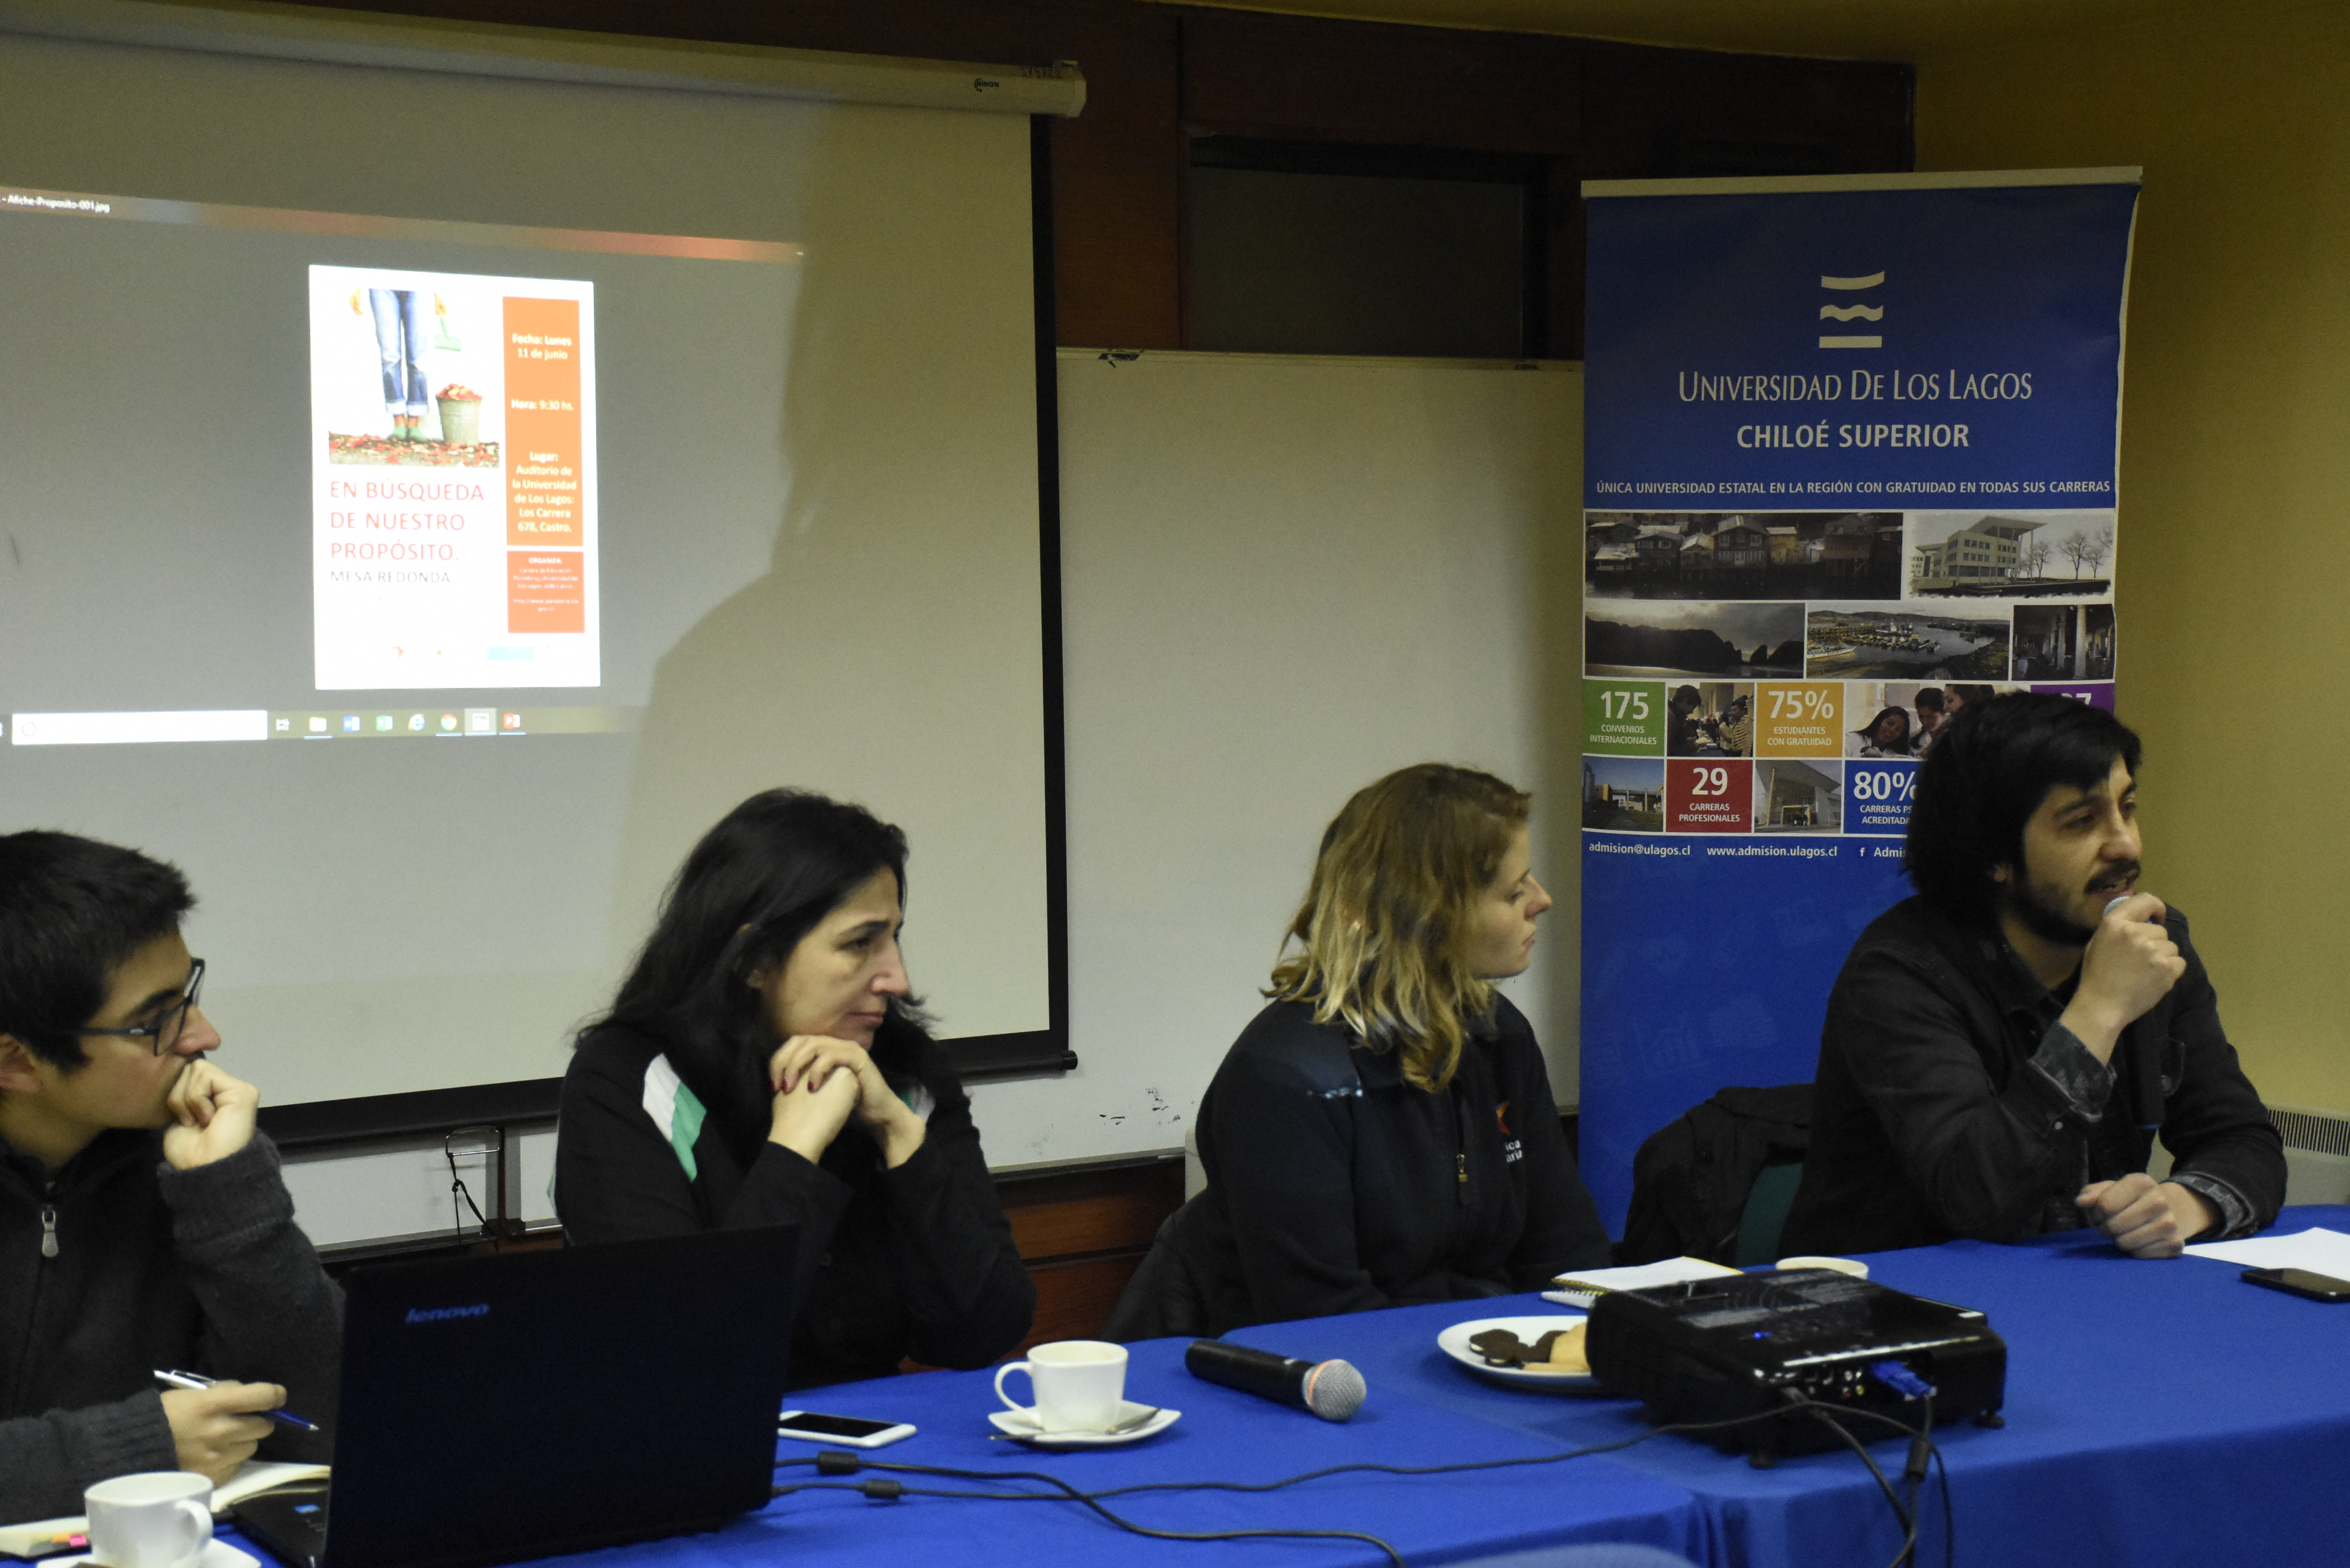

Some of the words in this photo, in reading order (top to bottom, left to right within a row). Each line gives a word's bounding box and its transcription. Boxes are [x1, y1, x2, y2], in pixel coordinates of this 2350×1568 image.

[512, 333, 544, 345] Fecha:
[544, 336, 572, 347] Lunes
[518, 348, 528, 358] 11
[531, 349, 543, 359] de
[544, 350, 569, 361] junio
[1679, 371, 1842, 402] UNIVERSIDAD
[1894, 370, 1940, 400] LOS
[1949, 369, 2032, 400] LAGOS
[511, 399, 537, 410] Hora:
[540, 401, 559, 410] 9:30
[561, 401, 573, 411] hs.
[1737, 419, 1829, 448] CHILOÉ
[1839, 424, 1969, 447] SUPERIOR
[529, 452, 558, 464] Lugar:
[516, 465, 558, 476] Auditorio
[560, 467, 573, 477] de
[331, 481, 356, 498] EN
[366, 478, 484, 502] BÚSQUEDA
[512, 479, 522, 489] la
[523, 480, 577, 490] Universidad
[1597, 480, 1633, 493] ÚNICA
[1636, 482, 1715, 493] UNIVERSIDAD
[1719, 482, 1766, 493] ESTATAL
[1770, 482, 1785, 493] EN
[1789, 482, 1804, 493] LA
[1807, 480, 1852, 493] REGIÓN
[1856, 482, 1882, 493] CON
[1885, 482, 1956, 493] GRATUIDAD
[1960, 482, 1976, 493] EN
[1979, 481, 2019, 493] TODAS
[2023, 481, 2046, 493] SUS
[2049, 480, 2110, 493] CARRERAS
[514, 493, 527, 503] de
[528, 494, 544, 504] Los
[519, 508, 535, 517] Los
[536, 508, 571, 518] Carrera
[331, 512, 355, 528] DE
[366, 513, 465, 531] NUESTRO
[517, 522, 538, 532] 678,
[539, 522, 572, 532] Castro.
[331, 539, 459, 561] PROPÓSITO.
[330, 571, 372, 582] MESA
[378, 571, 454, 583] REDONDA.
[1600, 691, 1649, 720] 175
[1768, 689, 1834, 720] 75%
[1601, 724, 1645, 734] CONVENIOS
[1773, 726, 1826, 734] ESTUDIANTES
[1590, 734, 1657, 745] INTERNACIONALES
[1767, 737, 1785, 746] CON
[1786, 737, 1832, 746] GRATUIDAD
[1692, 767, 1728, 795] 29
[1853, 771, 1916, 801] 80%
[1689, 803, 1730, 811] CARRERAS
[1860, 805, 1902, 813] CARRERAS
[1679, 814, 1740, 822] PROFESIONALES
[1589, 841, 1690, 858] admision@ulagos.cl
[1707, 845, 1837, 859] www.admision.ulagos.cl
